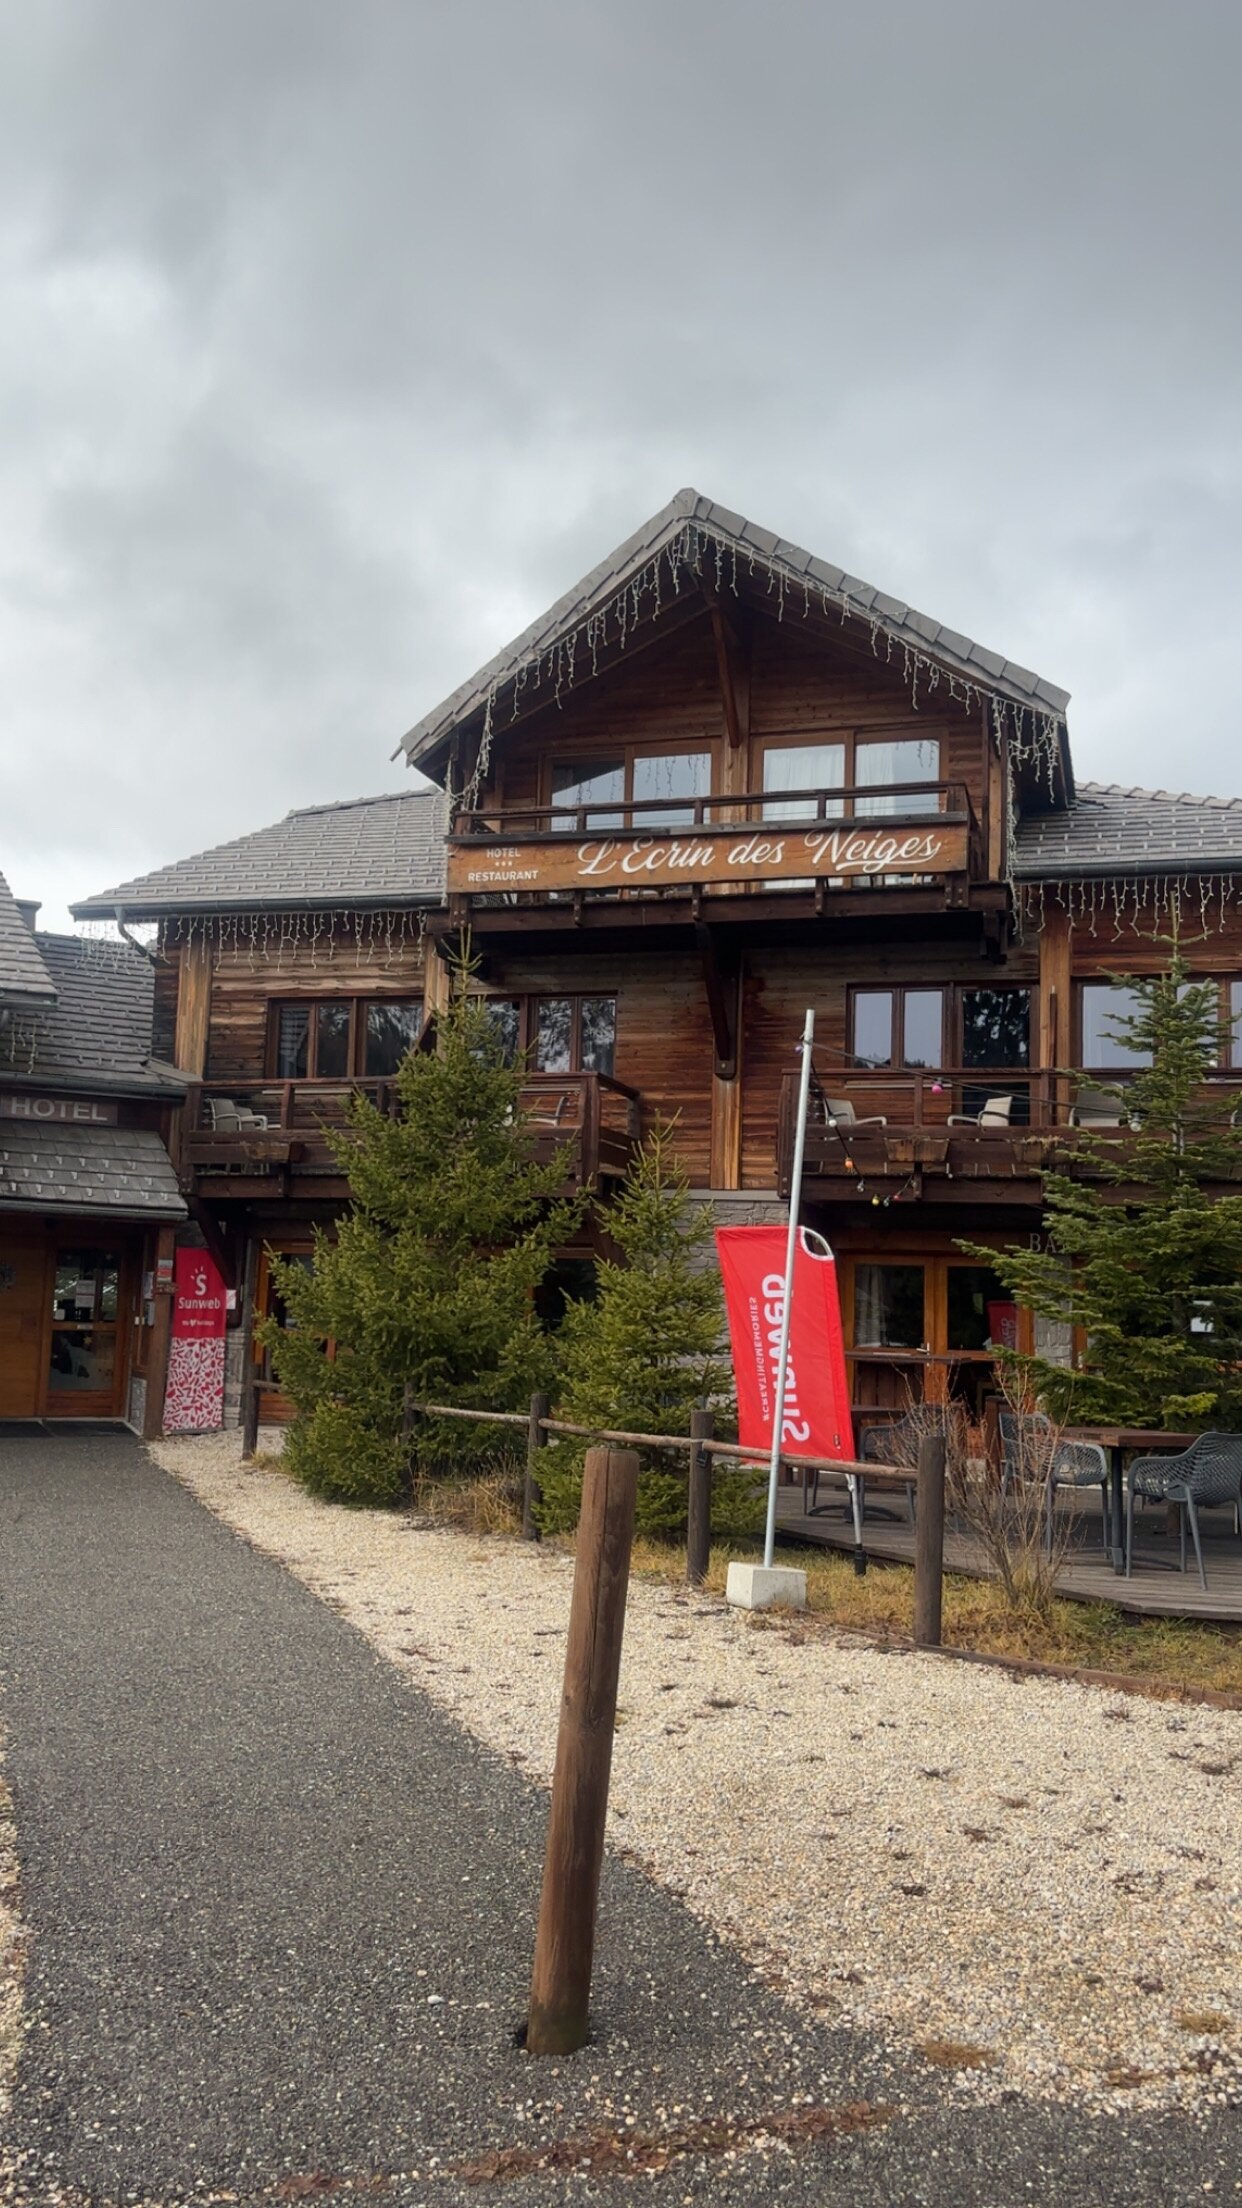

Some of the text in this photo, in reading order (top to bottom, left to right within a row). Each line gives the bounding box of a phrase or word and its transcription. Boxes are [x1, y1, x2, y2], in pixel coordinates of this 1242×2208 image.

[486, 847, 521, 859] HOTEL
[727, 832, 785, 865] des
[804, 827, 942, 874] Neiges
[467, 870, 539, 882] RESTAURANT
[11, 1097, 108, 1121] HOTEL
[1029, 1232, 1066, 1254] BA
[178, 1296, 221, 1310] Sunweb
